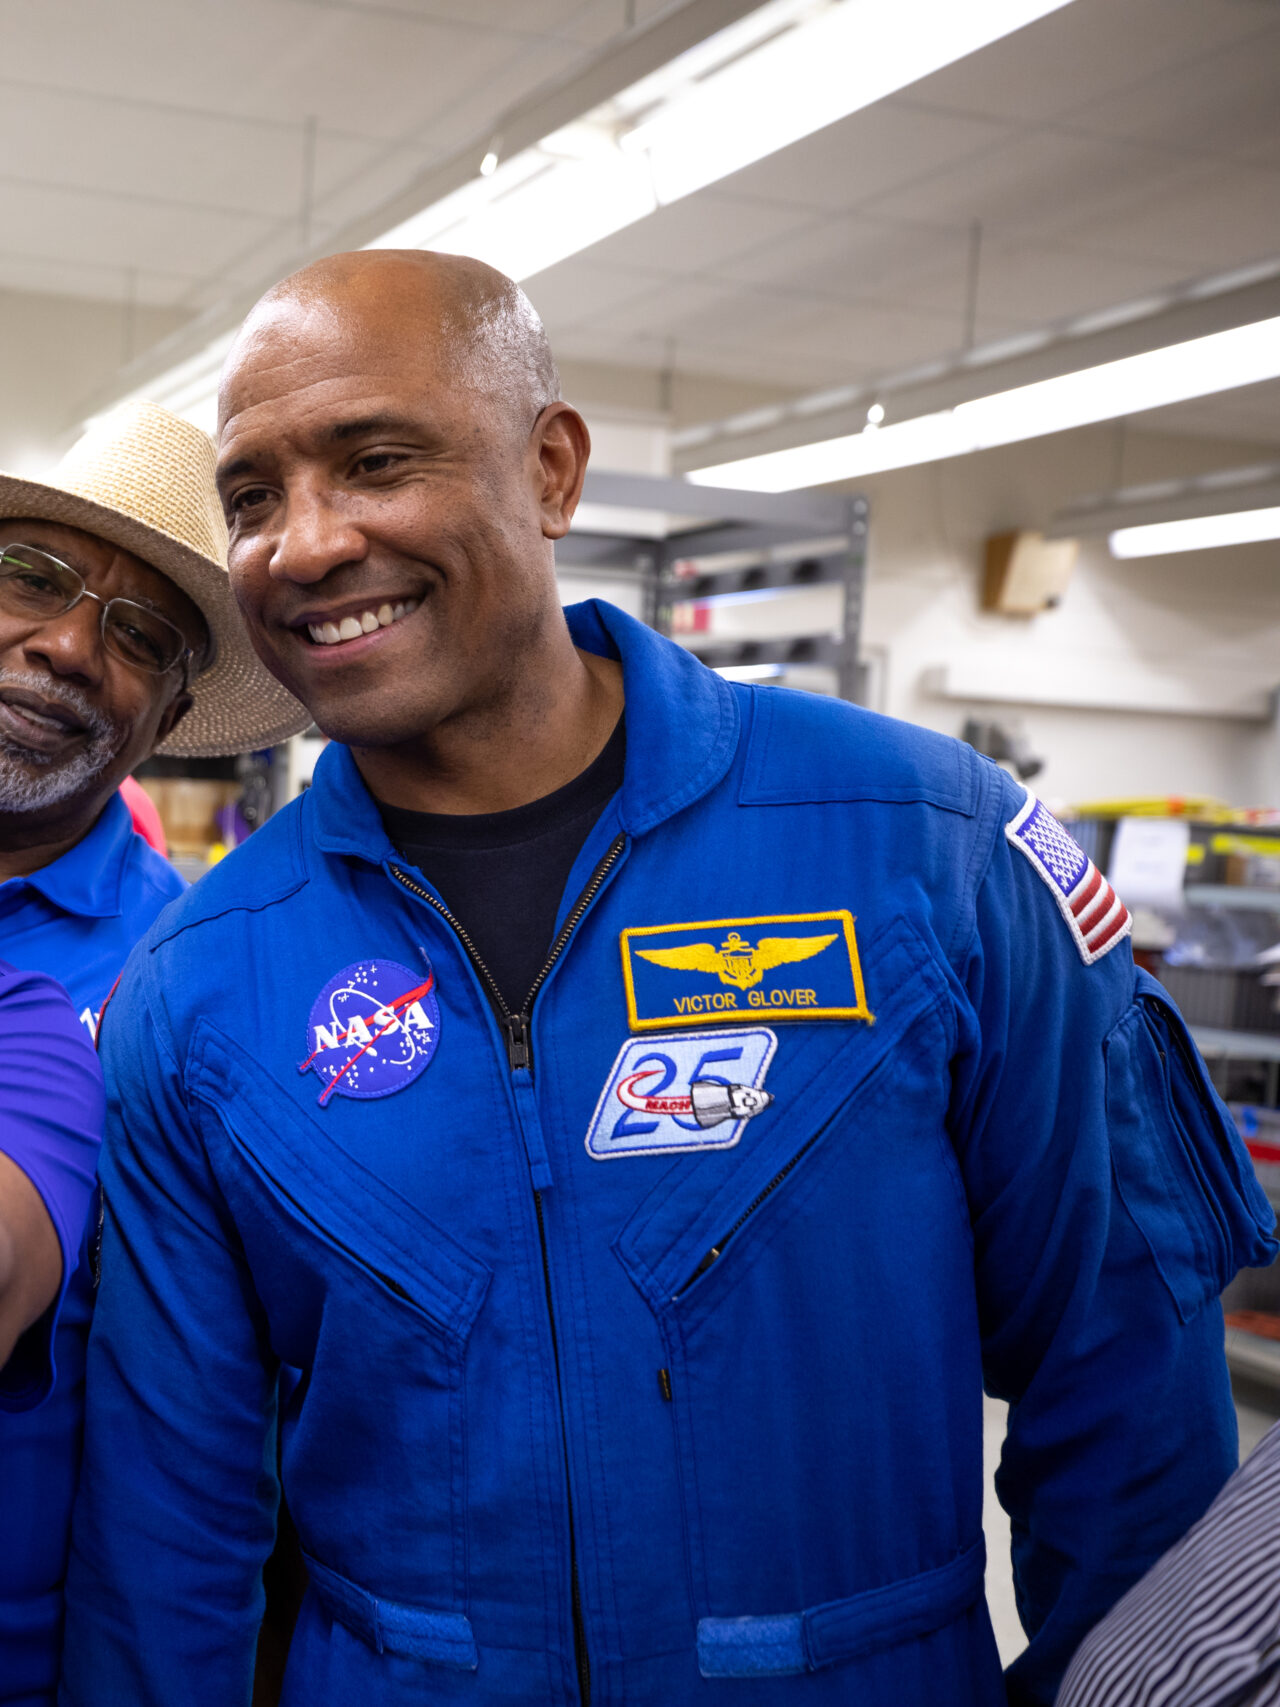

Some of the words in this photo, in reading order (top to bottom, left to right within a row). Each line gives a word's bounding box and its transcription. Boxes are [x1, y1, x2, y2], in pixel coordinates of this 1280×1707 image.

[673, 992, 737, 1013] VICTOR
[747, 989, 818, 1007] GLOVER
[313, 1002, 434, 1053] NASA
[645, 1099, 691, 1110] MACH
